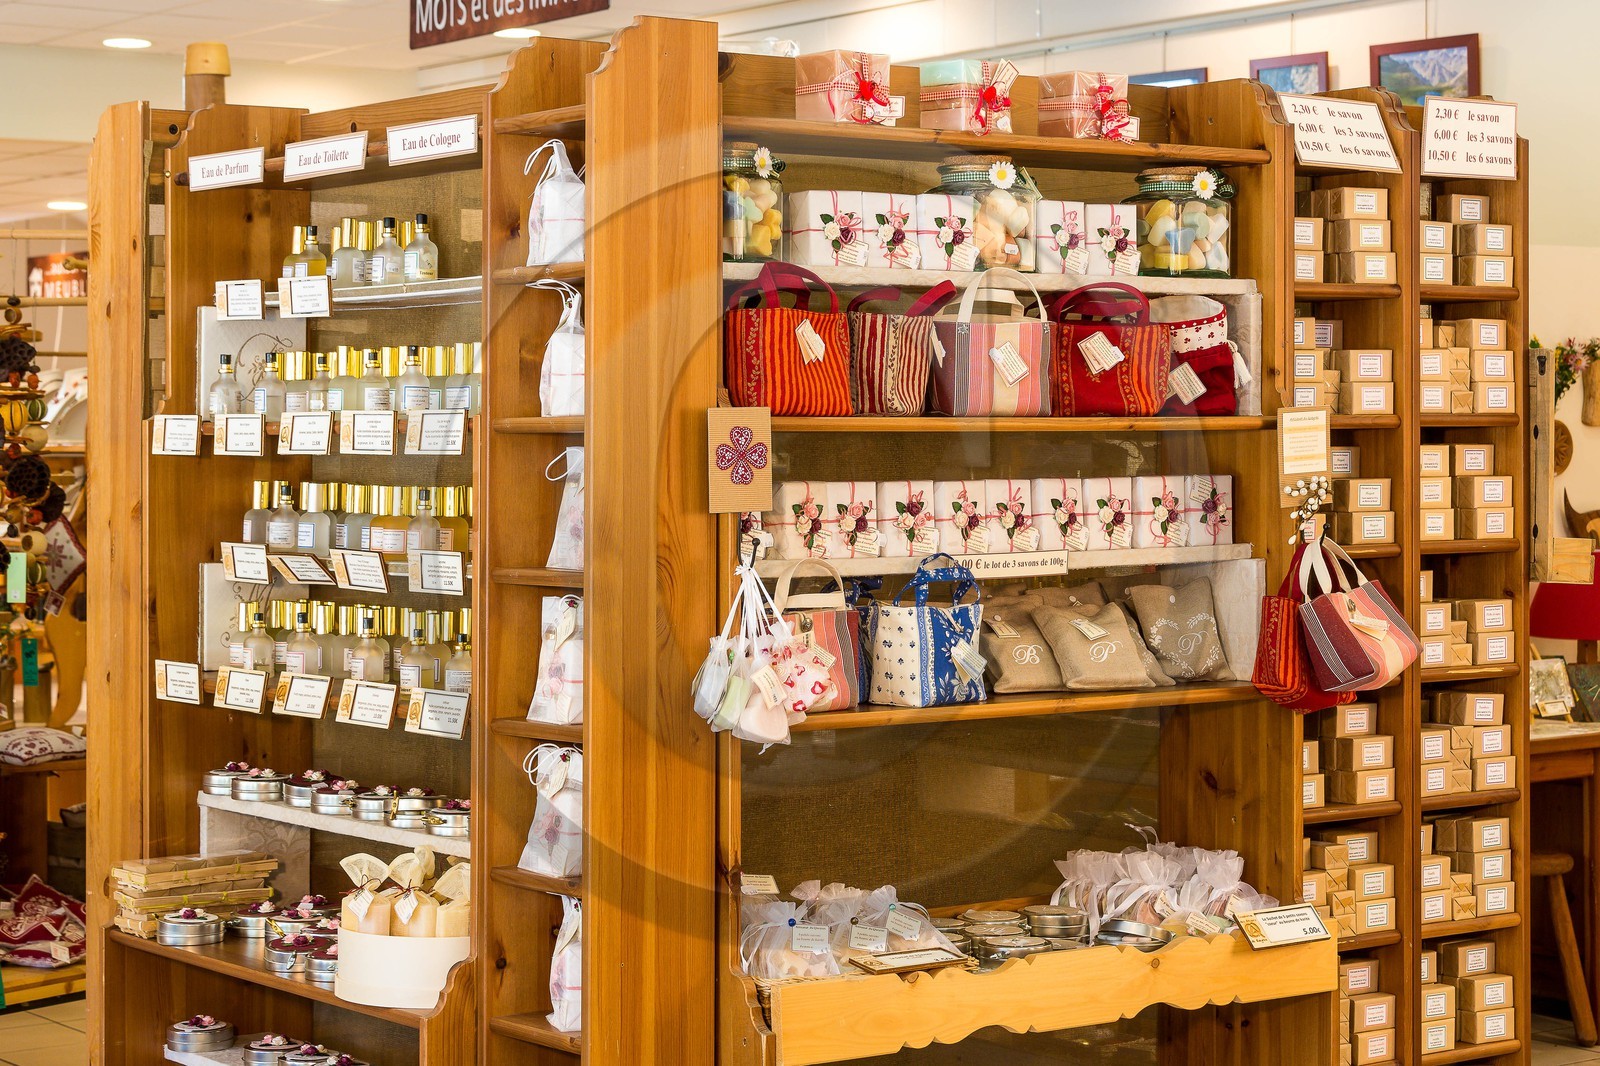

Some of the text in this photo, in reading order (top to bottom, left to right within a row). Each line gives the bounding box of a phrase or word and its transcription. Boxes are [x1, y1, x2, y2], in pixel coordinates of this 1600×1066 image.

[1292, 103, 1362, 120] 2,30 € le savon
[1435, 108, 1500, 123] 2,30 € le savon
[1298, 123, 1384, 141] 6,00 € les 3 savons
[1433, 129, 1513, 145] 6,00 € les 3 savons
[402, 133, 461, 151] Eau de Cologne
[1299, 140, 1391, 159] 10,50 € les 6 savons
[298, 150, 350, 167] Eau de Toilette
[1428, 149, 1513, 165] 10,50 € les 6 savons
[201, 163, 249, 179] Eau de Parfum
[975, 559, 983, 570] €
[983, 561, 990, 570] le
[991, 560, 1001, 569] lot
[1002, 560, 1011, 568] de
[1011, 559, 1016, 568] 3
[1017, 559, 1039, 568] savons
[1040, 558, 1048, 567] de
[1049, 557, 1064, 568] 100g
